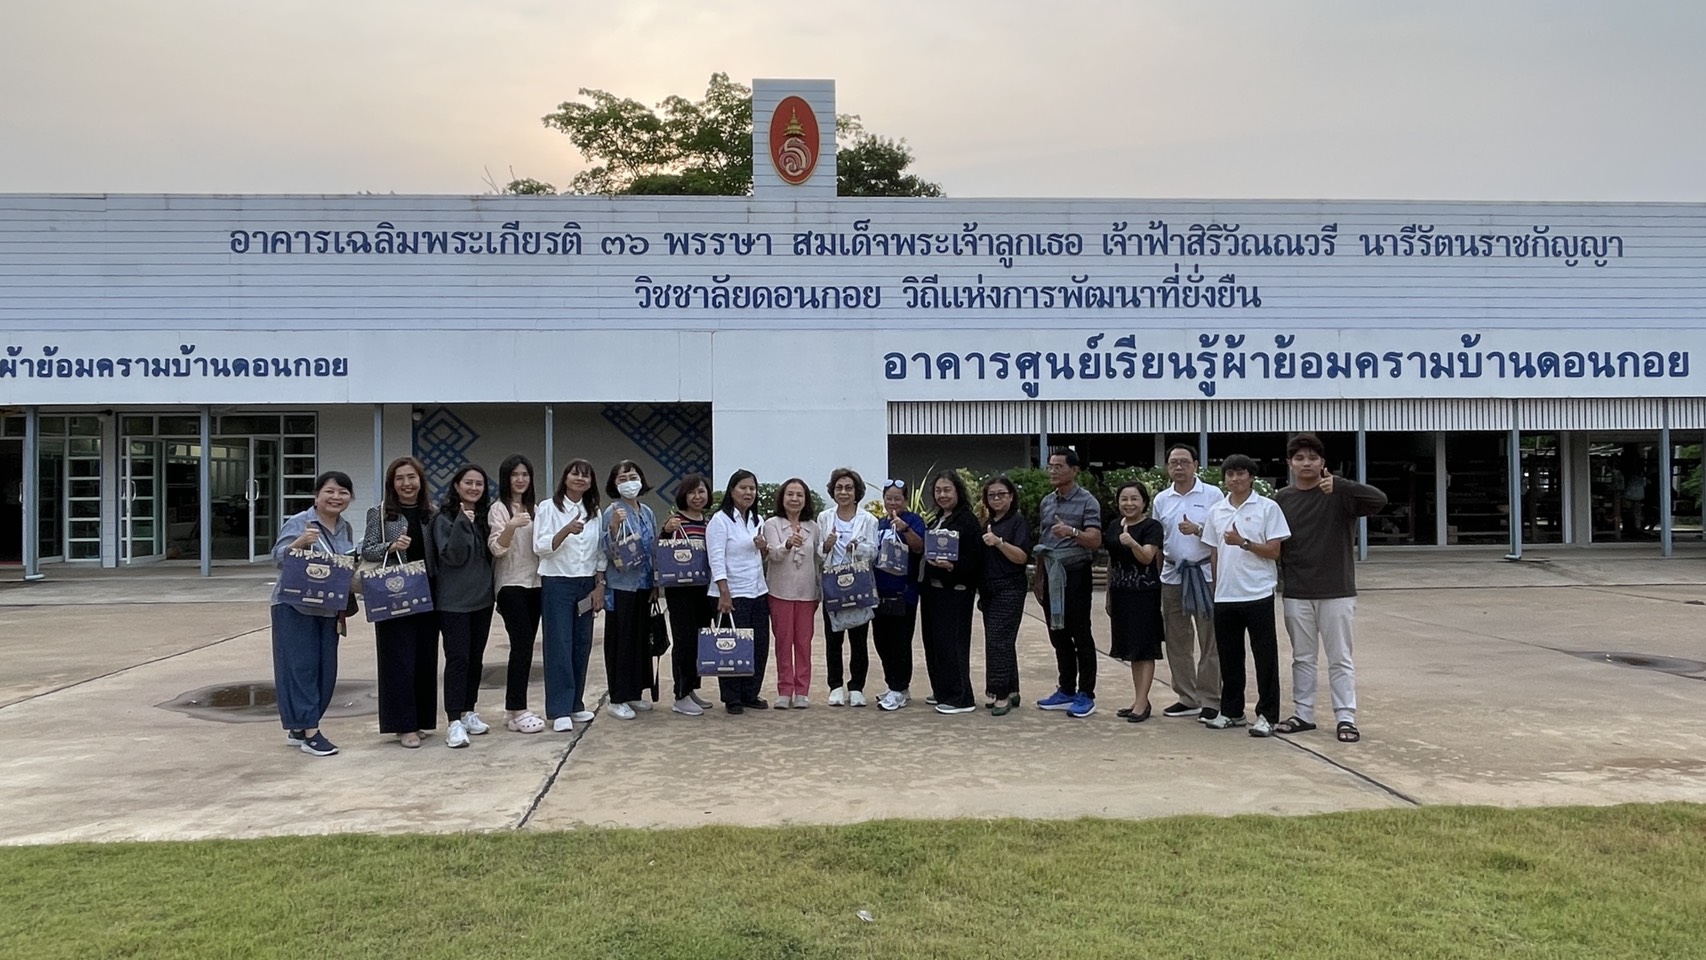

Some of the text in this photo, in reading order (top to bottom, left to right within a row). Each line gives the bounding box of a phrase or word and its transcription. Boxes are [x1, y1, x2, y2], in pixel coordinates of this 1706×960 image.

[229, 219, 1625, 268] อาคารเฉลิมพระเกียรติ ๓๖ พรรษา สมเด็จพระเจ้าลูกเธอ เจ้าฟ้าสิริวัณณวรี นารีรัตนราชกัญญา
[634, 263, 1262, 309] วิชชาลัยดอนกอย วิถีแห่งการพัฒนาที่ยั่งยืน
[883, 333, 1690, 399] อาคารศูนย์เรียนรู้ผ้าย้อมครามบ้านดอนกอย
